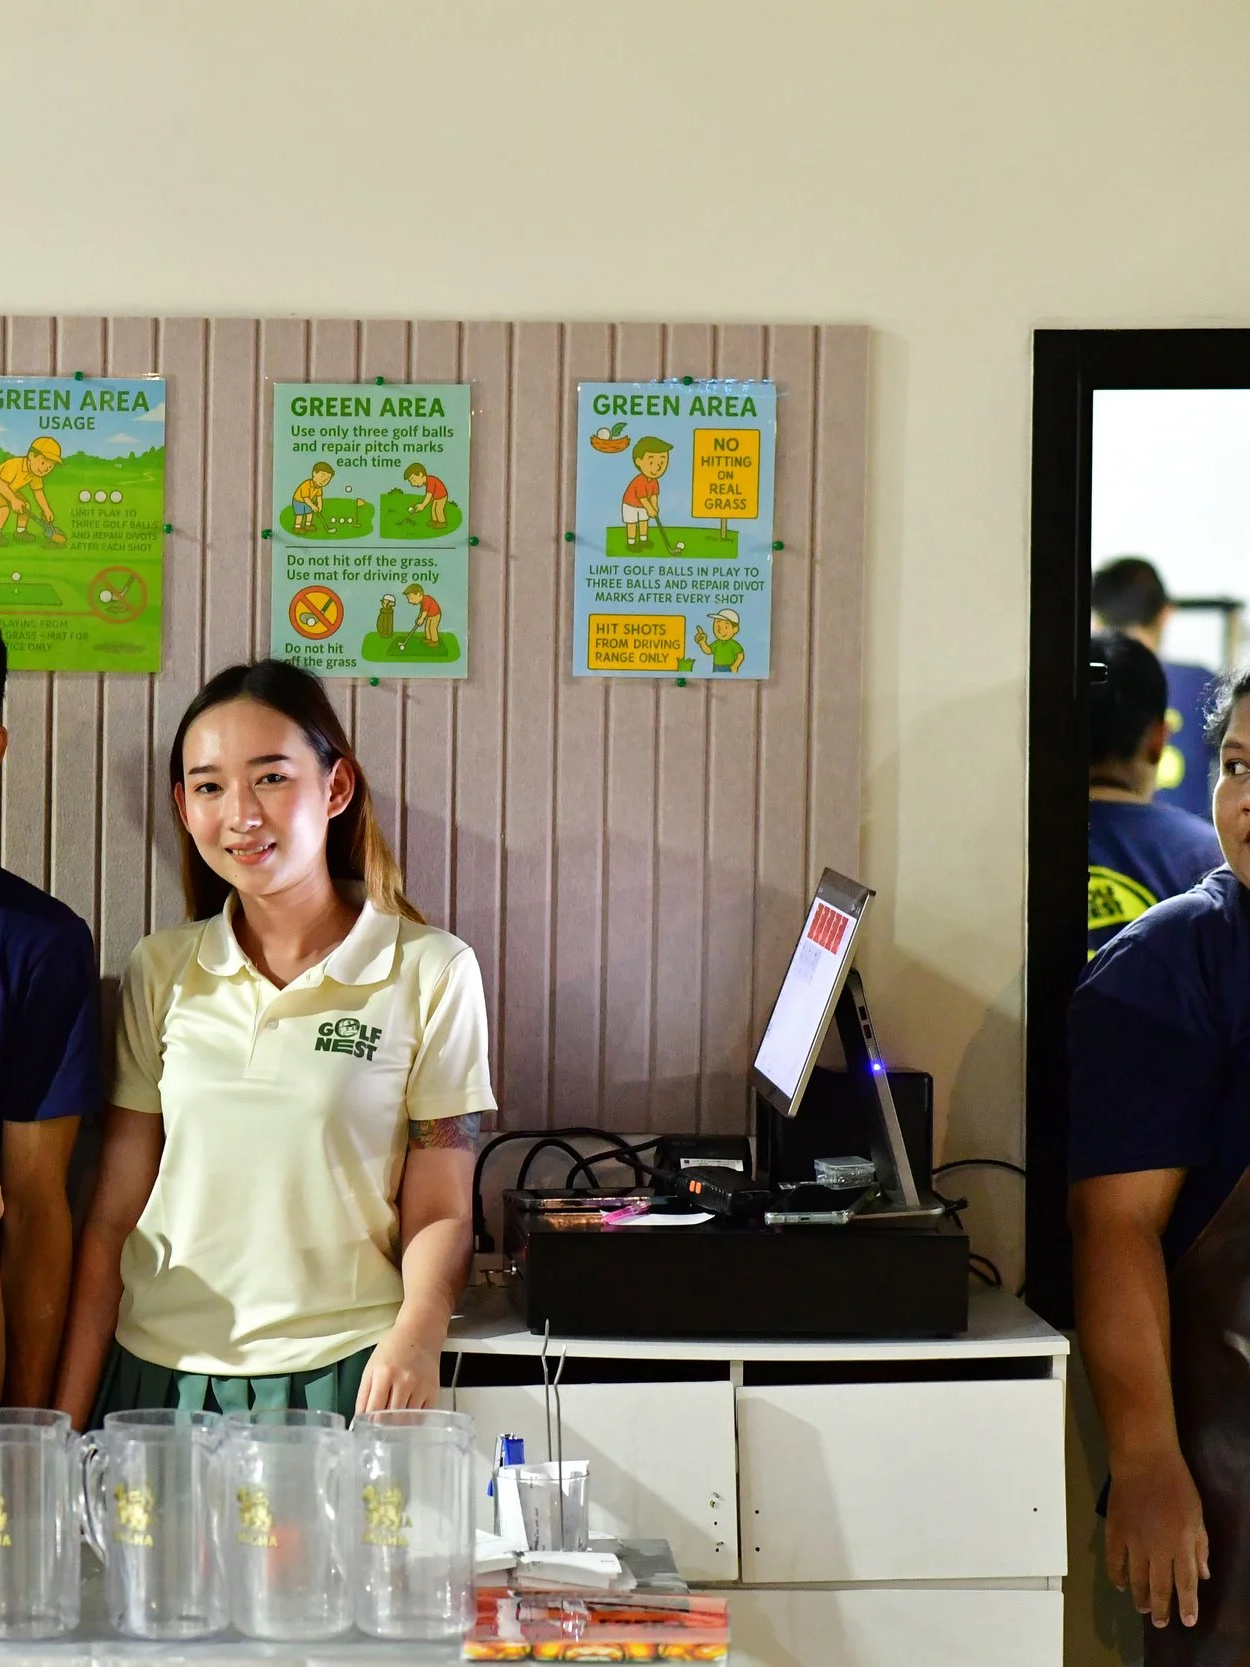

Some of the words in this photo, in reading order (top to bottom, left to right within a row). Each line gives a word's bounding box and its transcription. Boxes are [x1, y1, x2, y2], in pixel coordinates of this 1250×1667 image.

[79, 390, 149, 412] AREA
[593, 394, 680, 416] GREEN
[689, 396, 757, 417] AREA
[291, 397, 371, 417] GREEN
[380, 398, 445, 418] AREA
[39, 416, 95, 430] USAGE
[291, 425, 315, 437] Use
[320, 425, 349, 439] only
[353, 426, 388, 437] three
[393, 426, 418, 440] golf
[422, 426, 454, 438] balls
[293, 440, 317, 452] and
[321, 441, 360, 454] repair
[365, 440, 399, 454] pitch
[403, 441, 443, 453] marks
[714, 438, 739, 451] NO
[336, 456, 367, 467] each
[372, 456, 401, 468] time
[701, 456, 752, 467] HITTING
[718, 471, 734, 480] ON
[710, 484, 742, 495] REAL
[704, 498, 747, 510] GRASS
[70, 508, 95, 517] LIMIT
[98, 509, 120, 517] PLAY
[124, 509, 137, 517] TO
[71, 520, 99, 528] THREE
[102, 521, 127, 529] GOLF
[129, 521, 158, 530] BALLS
[92, 532, 122, 540] REPAIR
[125, 532, 157, 541] DIVOTS
[70, 543, 98, 551] AFTER
[127, 544, 152, 552] SHOT
[287, 555, 304, 566] Do
[309, 557, 329, 566] not
[334, 555, 350, 566] hit
[354, 555, 372, 566] off
[376, 556, 397, 567] the
[401, 557, 438, 569] grass.
[287, 570, 309, 580] Use
[314, 571, 338, 581] mat
[342, 570, 359, 580] for
[364, 570, 408, 583] driving
[412, 570, 439, 584] only
[589, 565, 619, 575] LIMIT
[624, 566, 655, 575] GOLF
[659, 566, 693, 576] BALLS
[698, 567, 708, 576] IN
[713, 567, 740, 577] PLAY
[745, 568, 759, 577] TO
[586, 579, 622, 588] THREE
[627, 579, 660, 589] BALLS
[665, 580, 687, 589] AND
[692, 580, 729, 590] REPAIR
[733, 581, 764, 591] DIVOT
[595, 593, 634, 602] MARKS
[638, 593, 672, 603] AFTER
[676, 594, 710, 603] EVERY
[715, 595, 744, 604] SHOT
[6, 631, 37, 639] GRASS
[596, 624, 618, 634] HIT
[624, 624, 666, 635] SHOTS
[26, 643, 53, 651] ONLY
[285, 643, 301, 653] Do
[304, 644, 324, 653] not
[327, 643, 343, 653] hit
[596, 639, 628, 648] FROM
[634, 639, 680, 649] DRIVING
[304, 657, 323, 667] the
[326, 658, 357, 669] grass
[595, 653, 634, 662] RANGE
[639, 653, 669, 663] ONLY
[318, 1018, 382, 1044] GOLF
[315, 1038, 377, 1061] NEST
